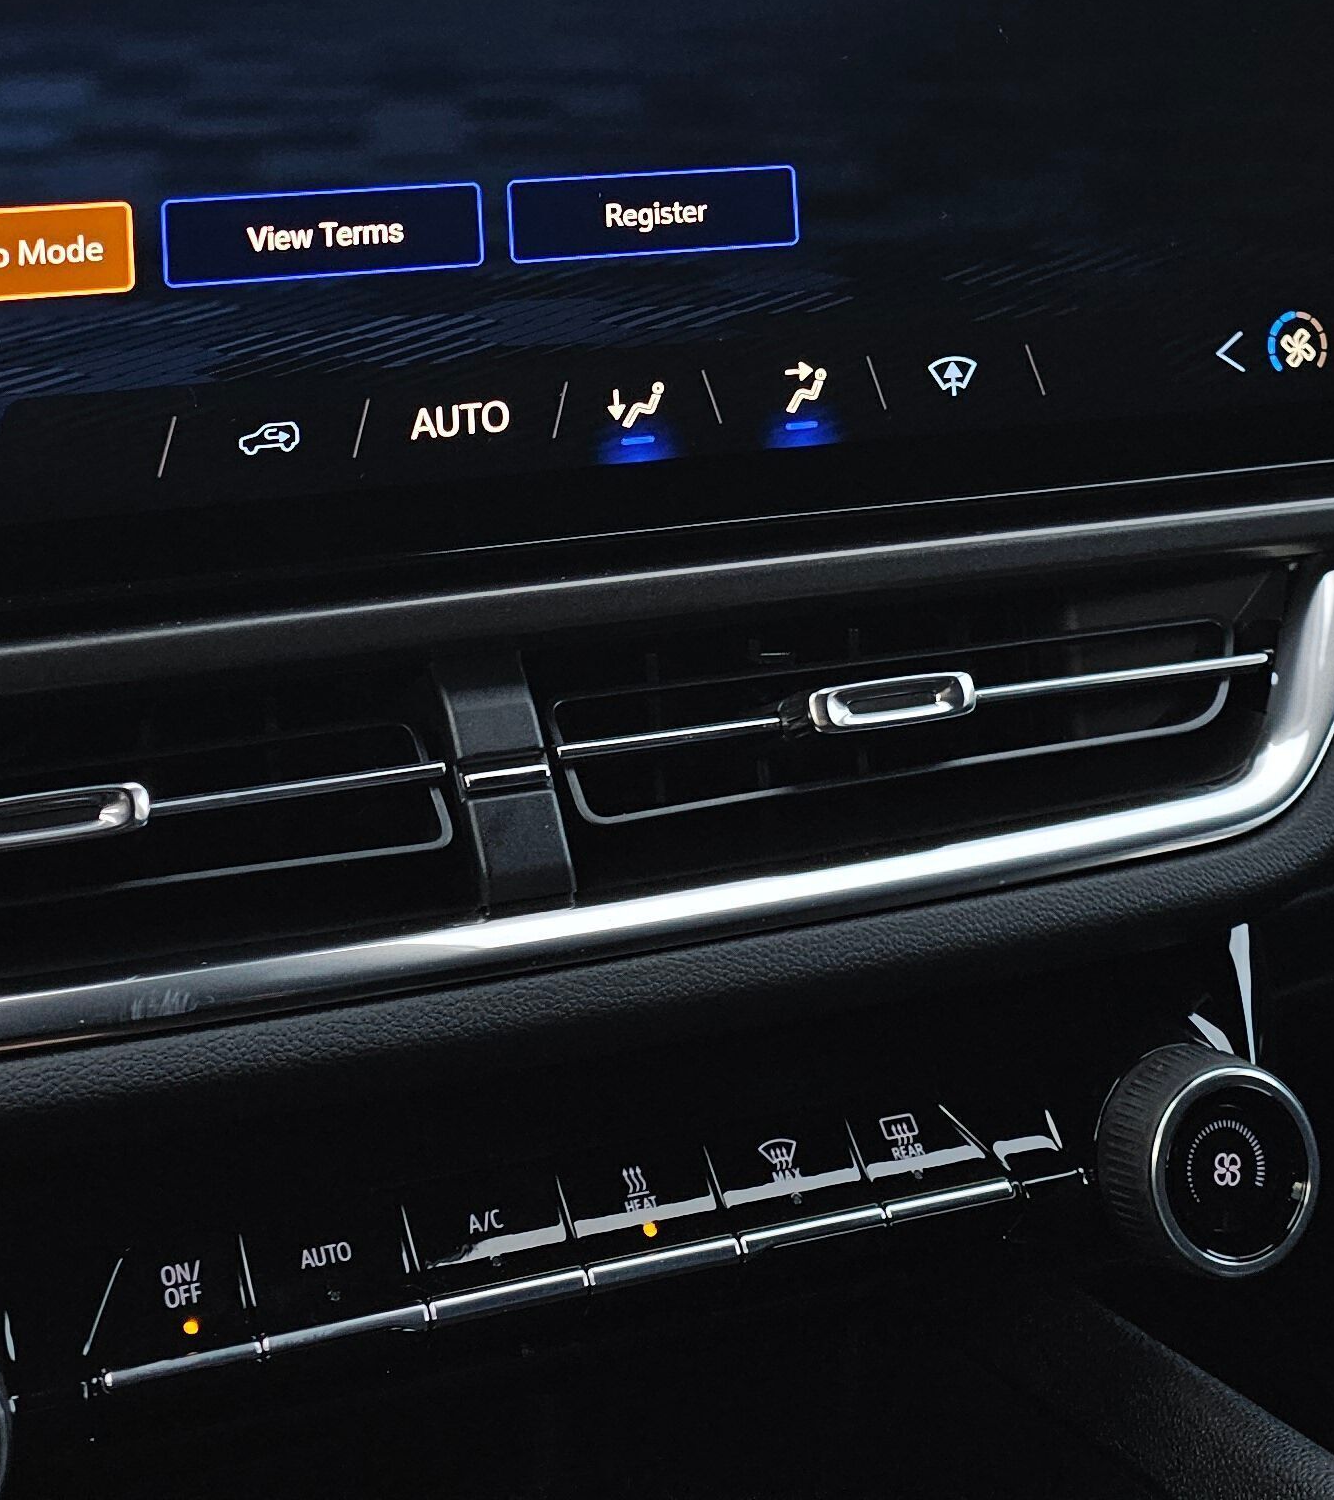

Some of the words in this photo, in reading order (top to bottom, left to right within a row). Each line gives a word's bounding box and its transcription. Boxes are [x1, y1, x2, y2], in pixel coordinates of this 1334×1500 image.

[605, 201, 708, 233] Register
[18, 234, 104, 267] Mode
[246, 225, 314, 253] View
[317, 221, 405, 248] Terms
[410, 399, 511, 441] AUTO
[891, 1143, 926, 1160] REAR
[772, 1167, 802, 1184] MAX
[624, 1195, 657, 1213] HEAT
[469, 1208, 504, 1234] A/C
[301, 1241, 352, 1270] AUTO
[161, 1259, 200, 1287] ON/
[164, 1283, 202, 1309] OFF
